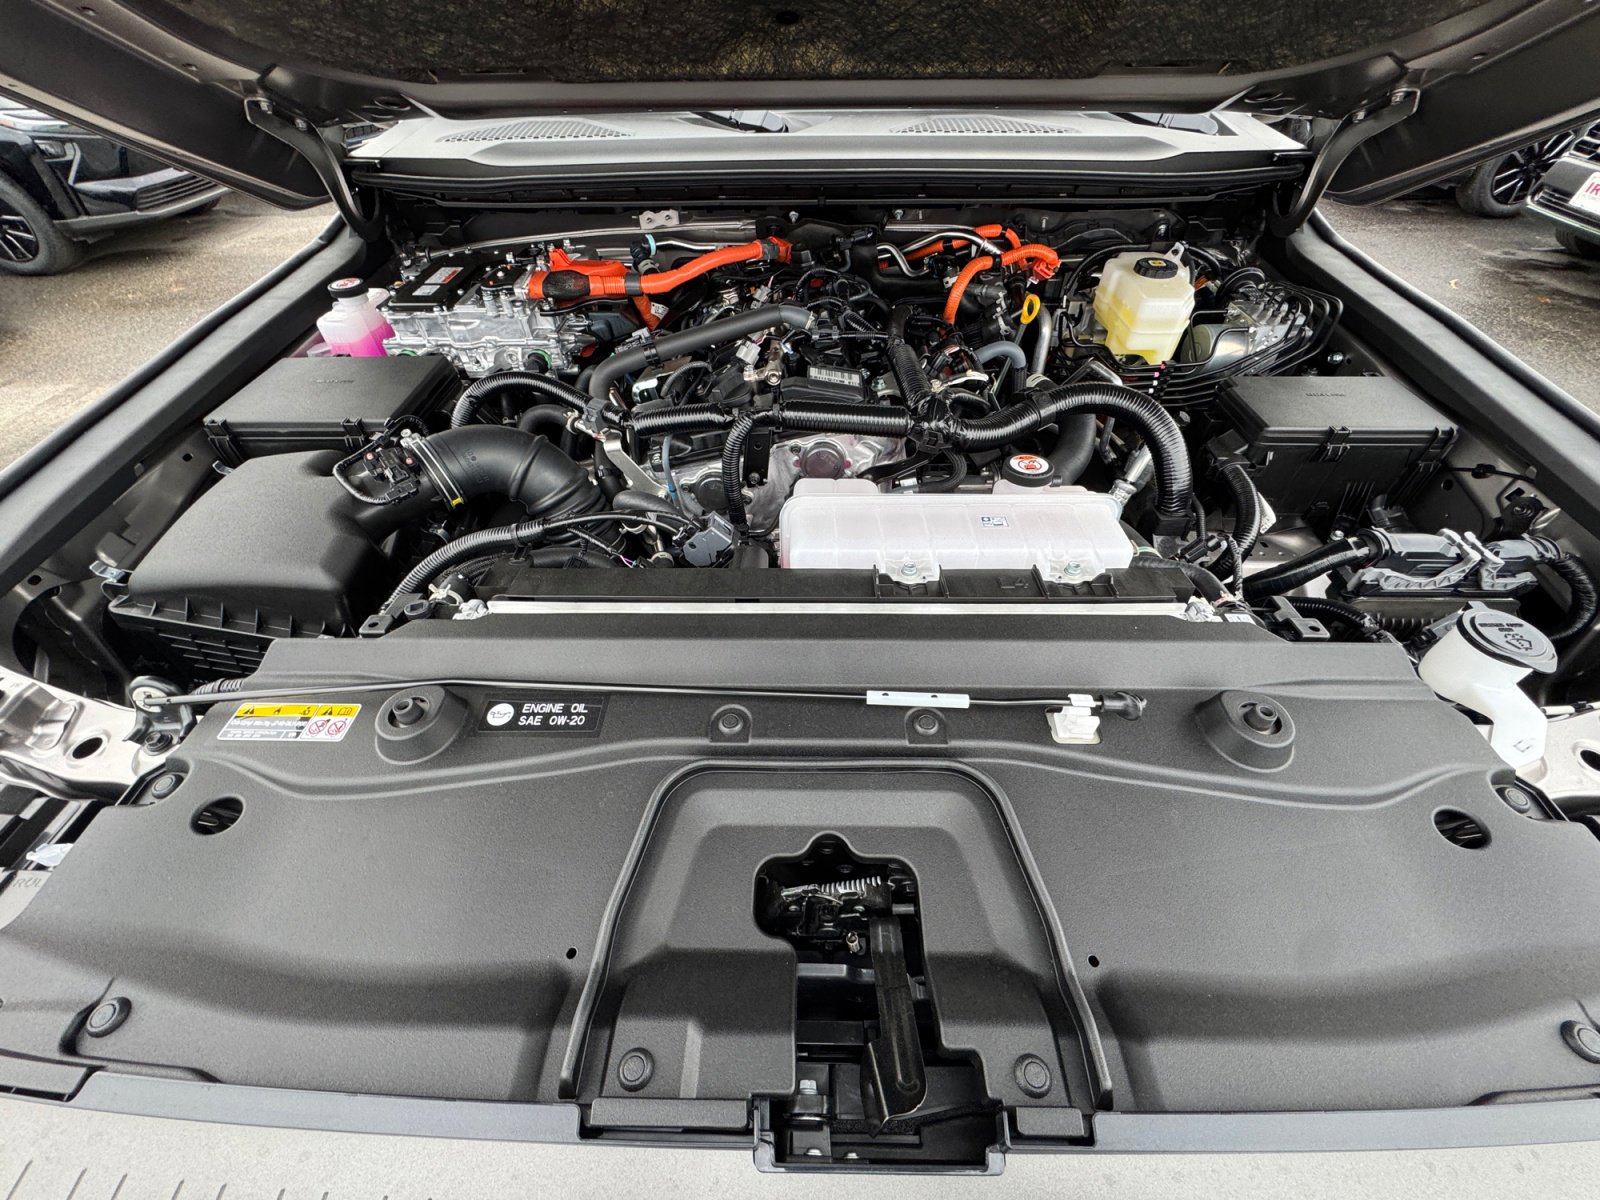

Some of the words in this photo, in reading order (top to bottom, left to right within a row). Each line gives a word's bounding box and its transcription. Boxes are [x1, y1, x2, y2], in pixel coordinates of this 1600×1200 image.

[522, 703, 565, 713] ENGINE
[570, 703, 588, 713] OIL
[518, 715, 543, 726] SAE
